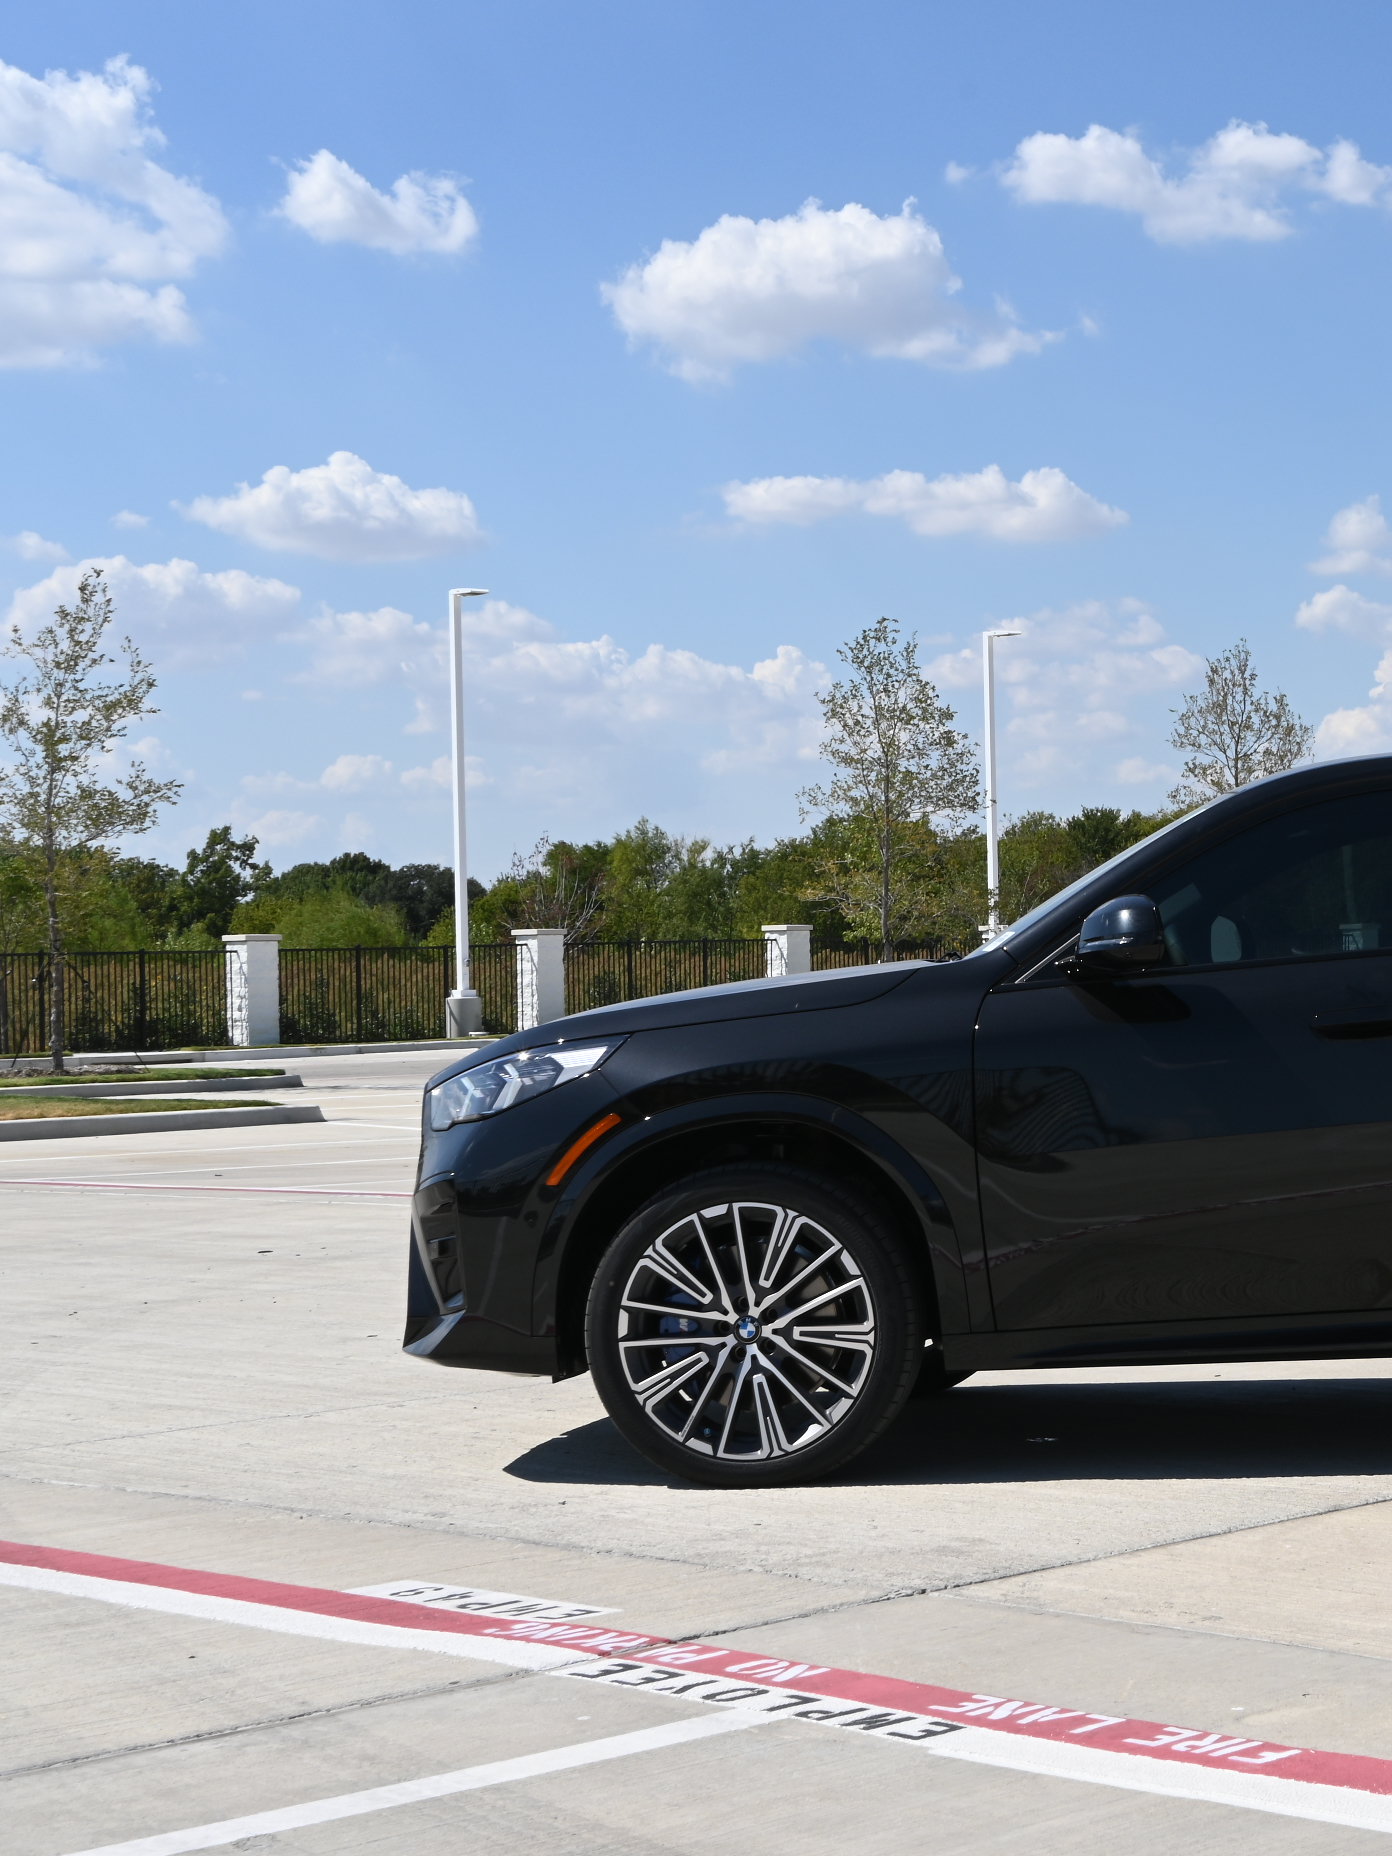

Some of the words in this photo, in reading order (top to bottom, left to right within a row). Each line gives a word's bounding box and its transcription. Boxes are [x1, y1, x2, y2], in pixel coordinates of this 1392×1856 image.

[483, 1621, 729, 1666] PARKING
[724, 1658, 832, 1684] NO
[570, 1661, 968, 1741] EMPLOYEE
[929, 1694, 1128, 1735] LANE
[1124, 1725, 1302, 1765] FIRE
